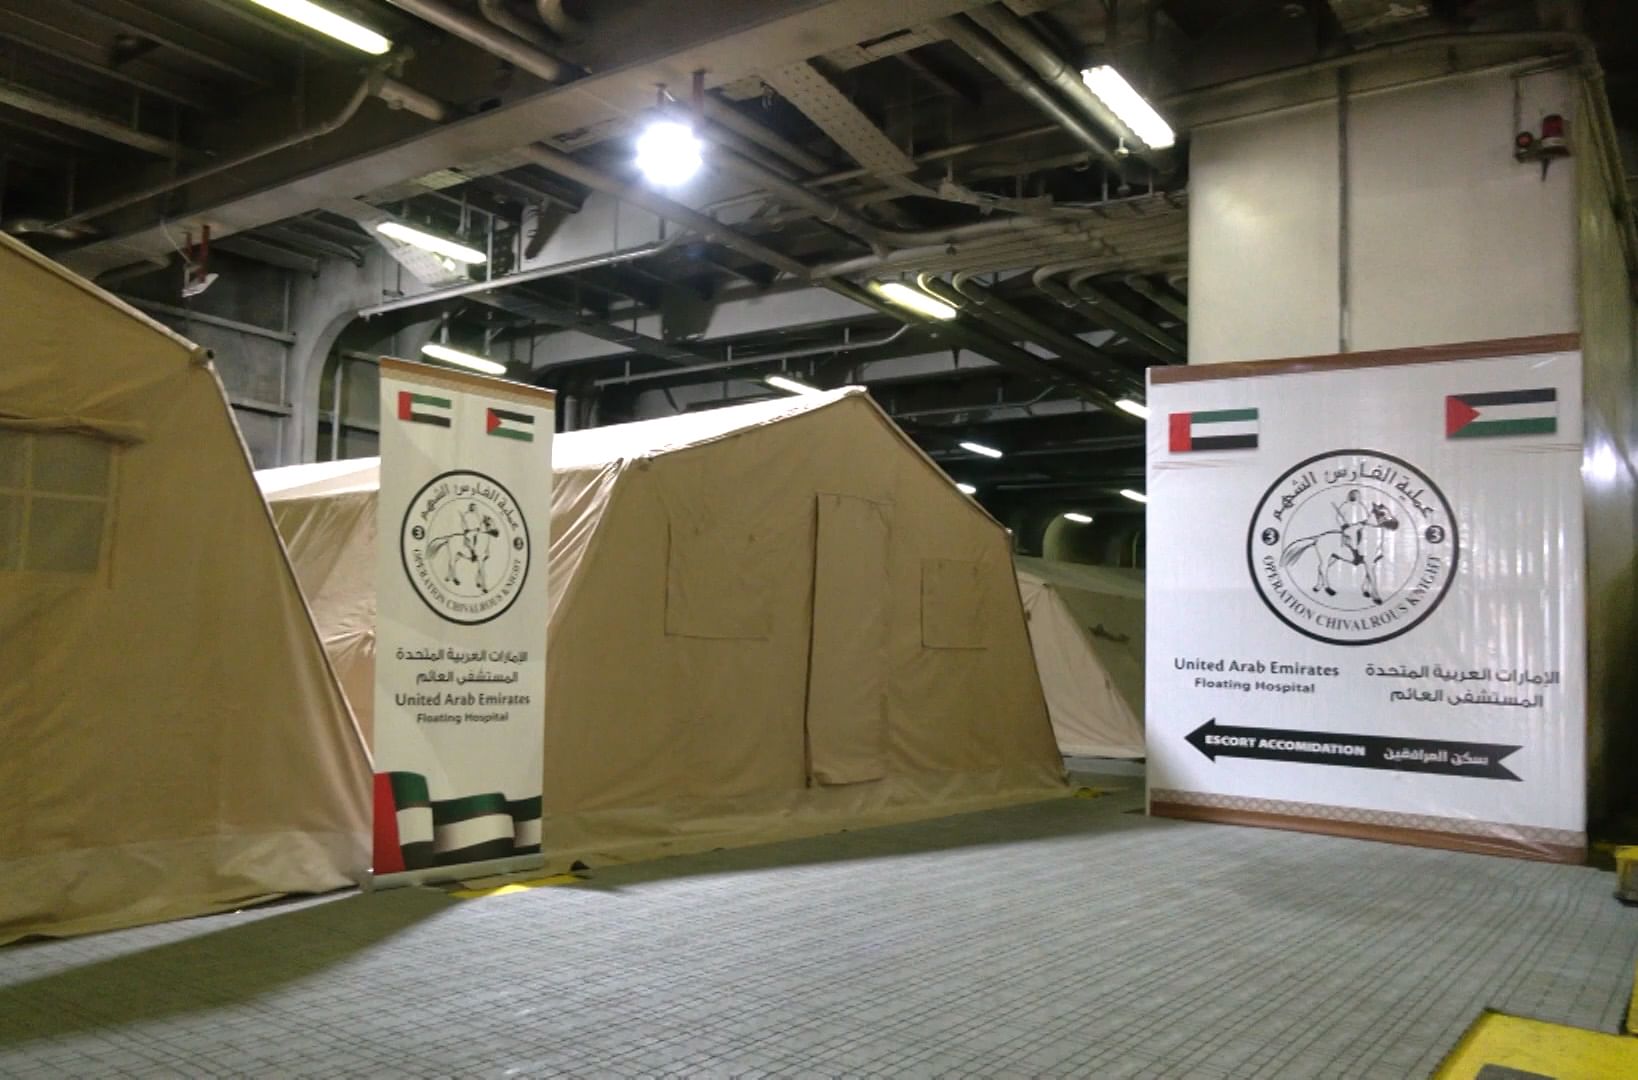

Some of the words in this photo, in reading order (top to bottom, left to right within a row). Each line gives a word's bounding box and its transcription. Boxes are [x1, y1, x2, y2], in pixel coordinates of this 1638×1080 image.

[1396, 474, 1434, 519] عملية
[1262, 554, 1314, 621] OPERATION
[1314, 603, 1409, 632] CHIVALROUS
[1409, 556, 1442, 607] KNIGHT
[1174, 657, 1225, 672] United
[1228, 660, 1266, 674] Arab
[1270, 661, 1340, 677] Emirates
[1365, 662, 1430, 679] المتحدة
[1433, 663, 1491, 682] العربية
[1194, 677, 1251, 692] Floating
[1255, 681, 1316, 694] Hospital
[395, 692, 441, 706] United
[444, 692, 476, 706] Arab
[478, 691, 531, 706] Emirates
[416, 713, 462, 724] Floating
[464, 712, 509, 724] Hospital
[1204, 734, 1256, 748] ESCORT
[1257, 738, 1366, 756] ACCOMIDATION
[1383, 746, 1448, 763] المرافقين
